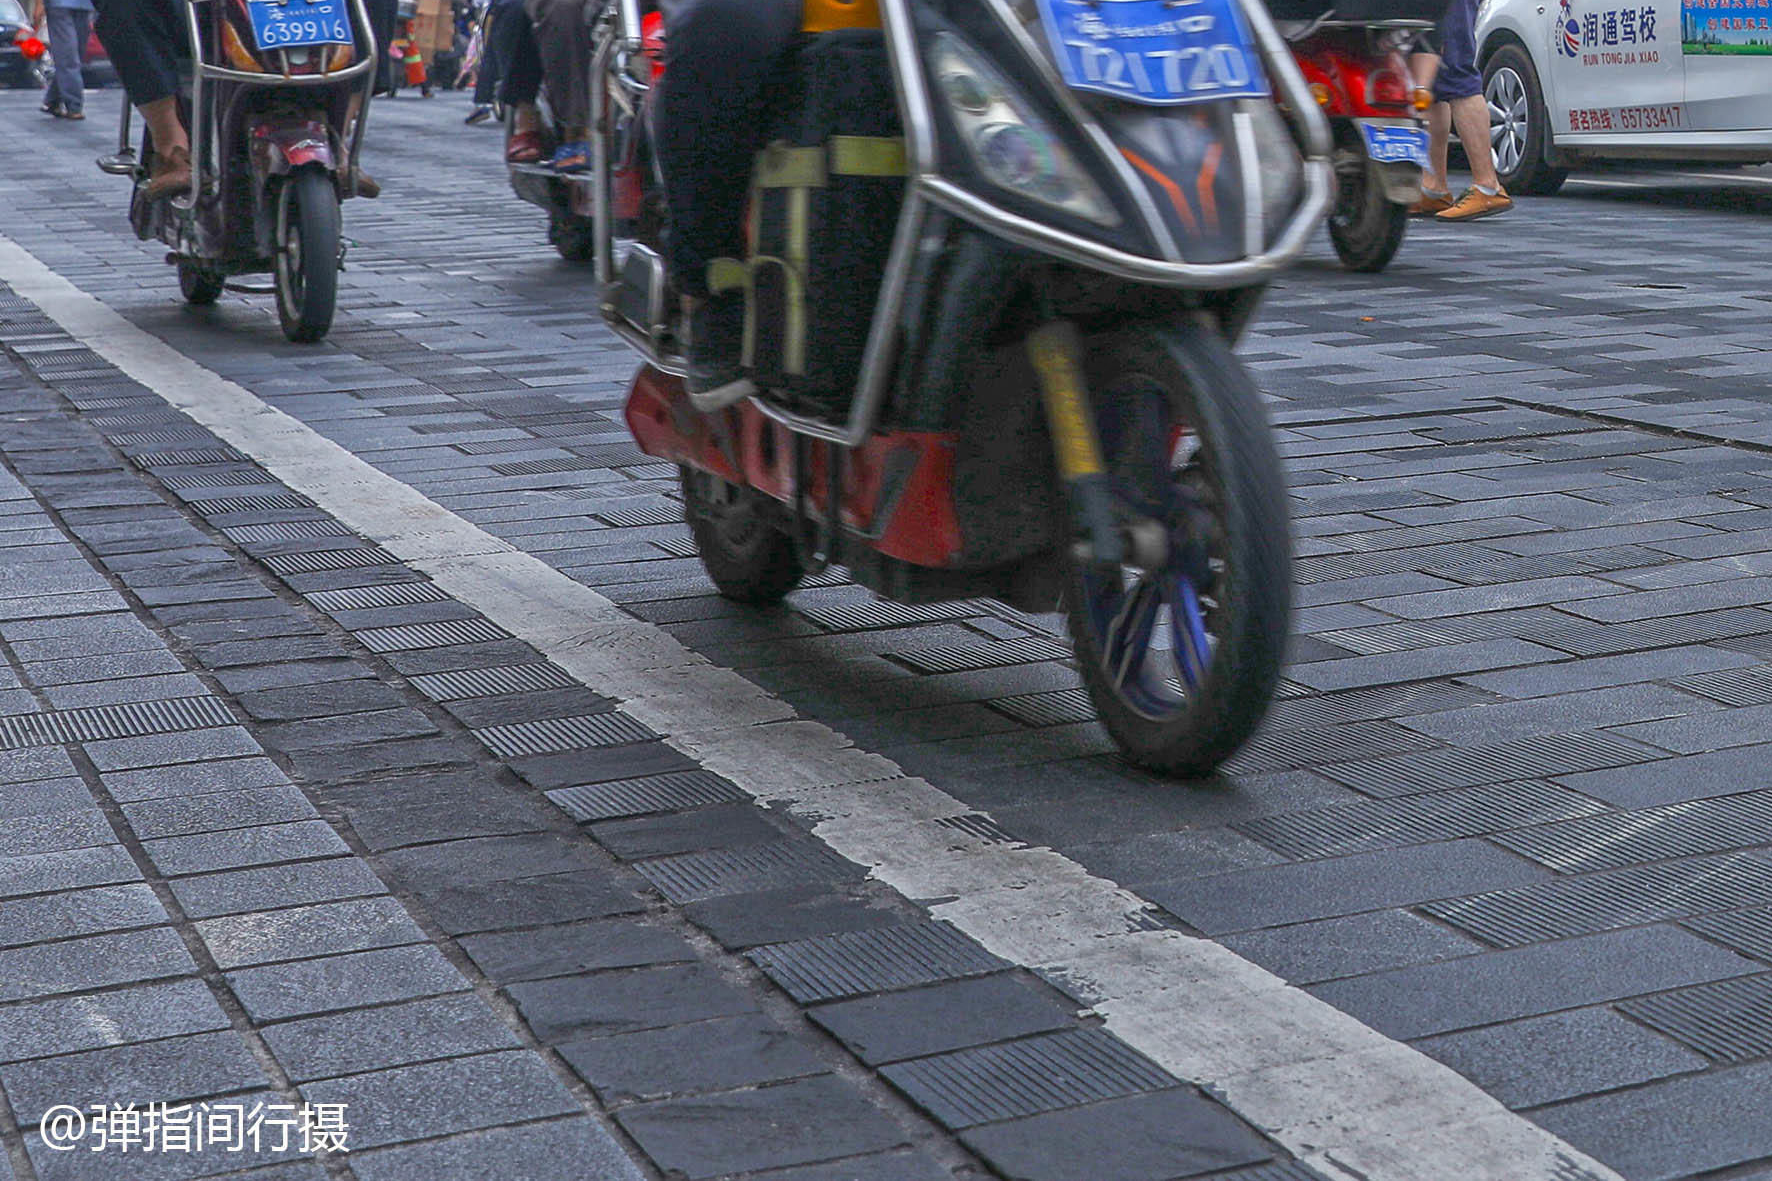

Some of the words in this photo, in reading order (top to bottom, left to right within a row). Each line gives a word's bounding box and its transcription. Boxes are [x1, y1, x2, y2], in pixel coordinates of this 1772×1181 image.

[263, 19, 345, 44] 639916
[1582, 6, 1657, 47] 润通驾校
[1583, 53, 1599, 66] RUN
[1601, 52, 1623, 64] TONG
[1624, 51, 1637, 63] JIA
[1639, 50, 1659, 63] XIAO
